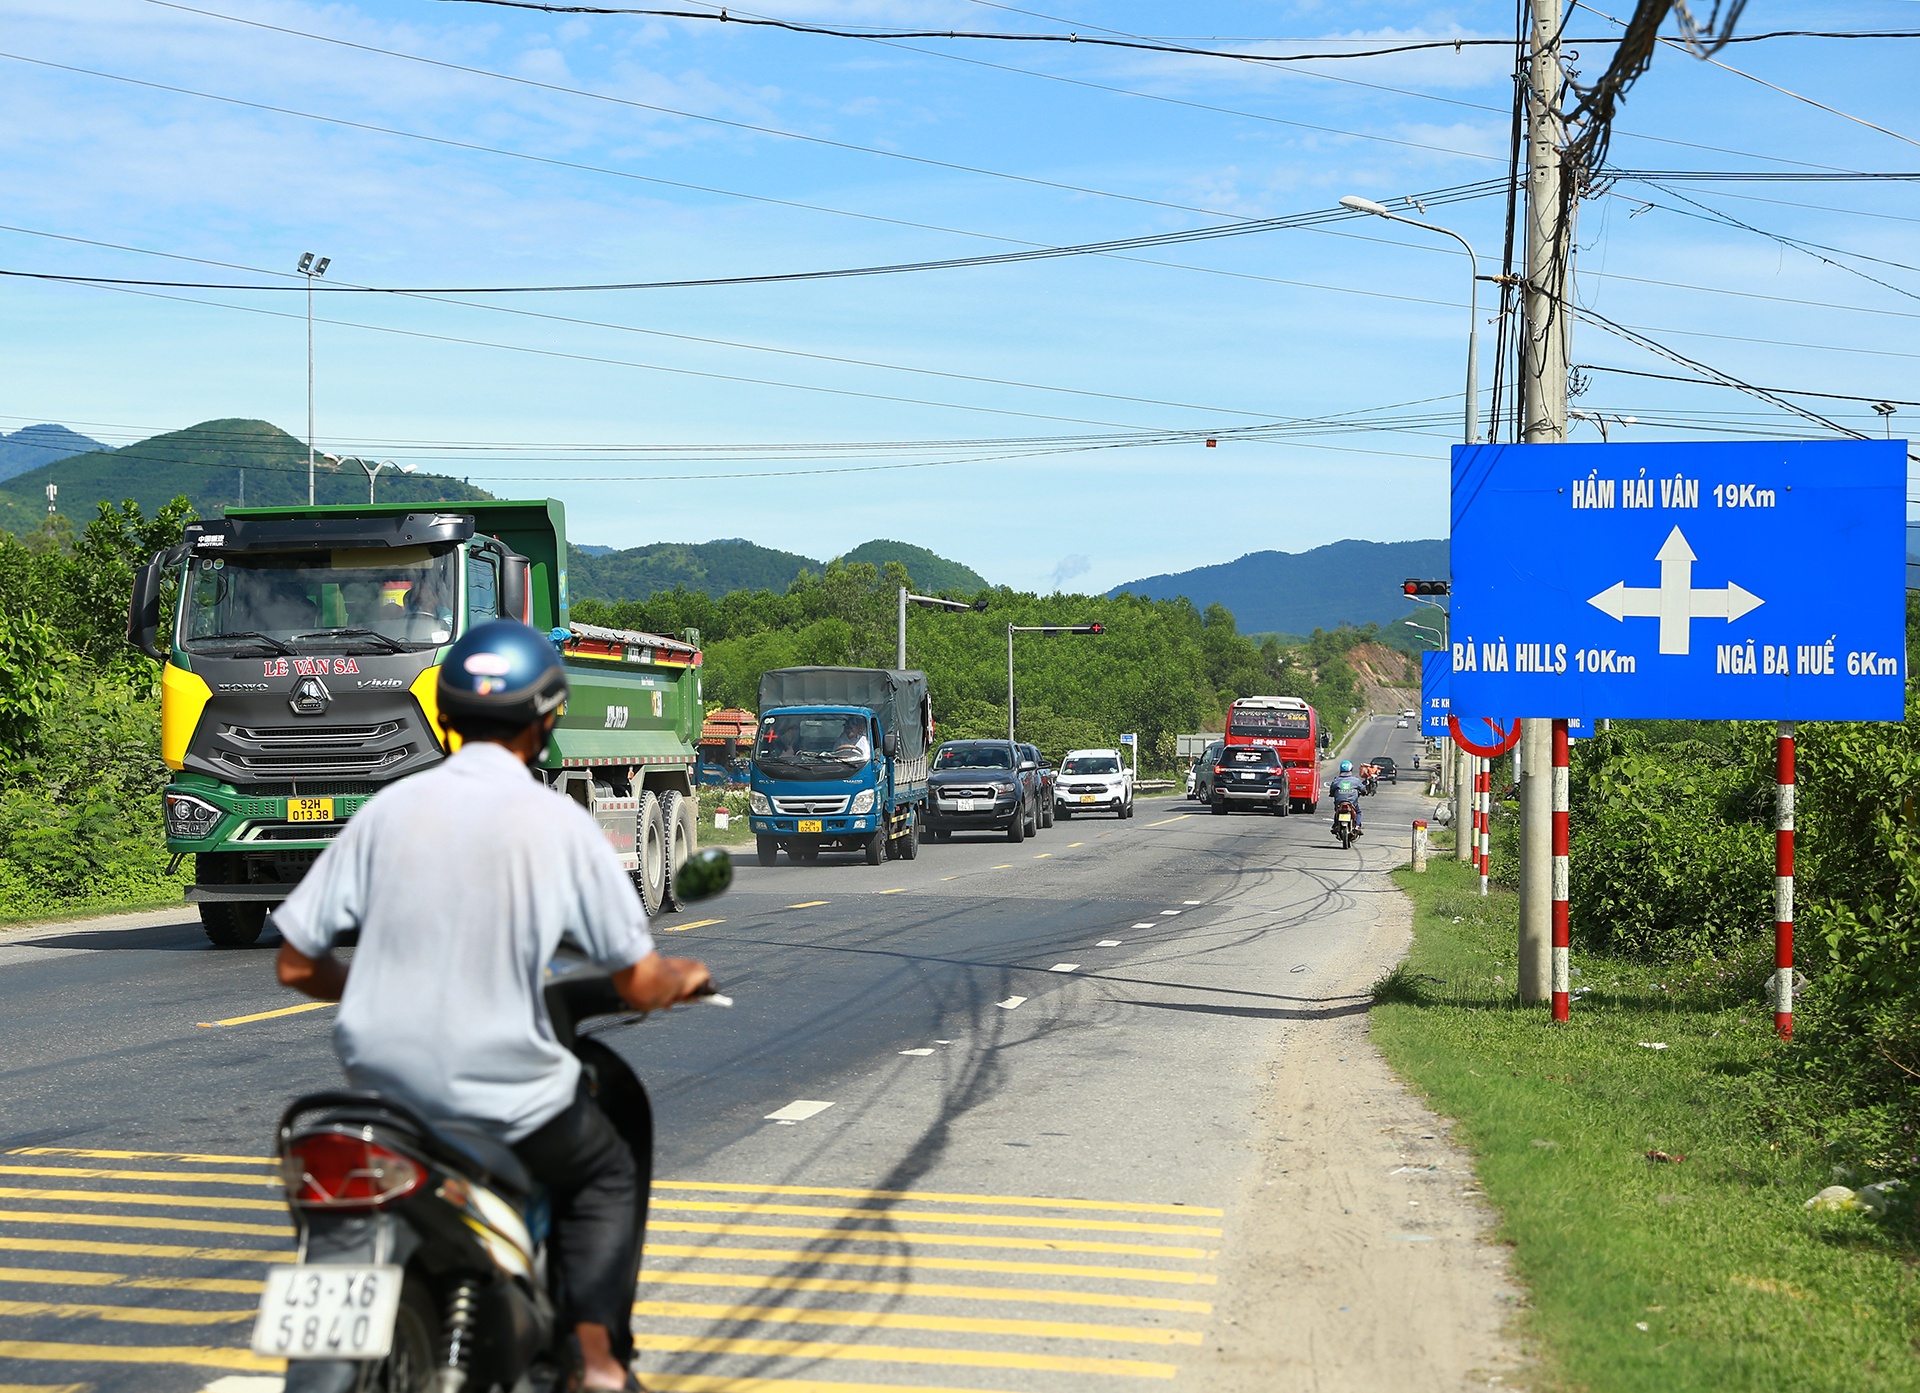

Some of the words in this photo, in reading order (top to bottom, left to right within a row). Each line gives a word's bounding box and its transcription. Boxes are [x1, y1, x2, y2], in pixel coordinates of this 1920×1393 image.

[1572, 468, 1615, 509] HẦM
[1622, 467, 1654, 508] HẢI
[1660, 473, 1699, 508] VÂN
[1713, 483, 1776, 508] 19Km
[1452, 636, 1478, 673] BÀ
[1482, 636, 1509, 672] NÀ
[1515, 643, 1567, 673] HILLS
[1575, 649, 1636, 673] 10Km
[1716, 638, 1757, 674] NGÃ
[1763, 645, 1789, 675] BA
[1797, 634, 1837, 675] HUẾ
[1847, 651, 1898, 676] 6Km
[264, 657, 289, 677] LÊ
[293, 656, 330, 676] VĂN
[334, 658, 360, 674] SA
[218, 683, 269, 692] HOWO
[1431, 698, 1440, 708] XE
[1441, 698, 1450, 708] KH
[1430, 716, 1440, 727] XE
[300, 799, 321, 810] 92H
[292, 810, 329, 821] 013.38
[276, 1314, 370, 1350] 5840
